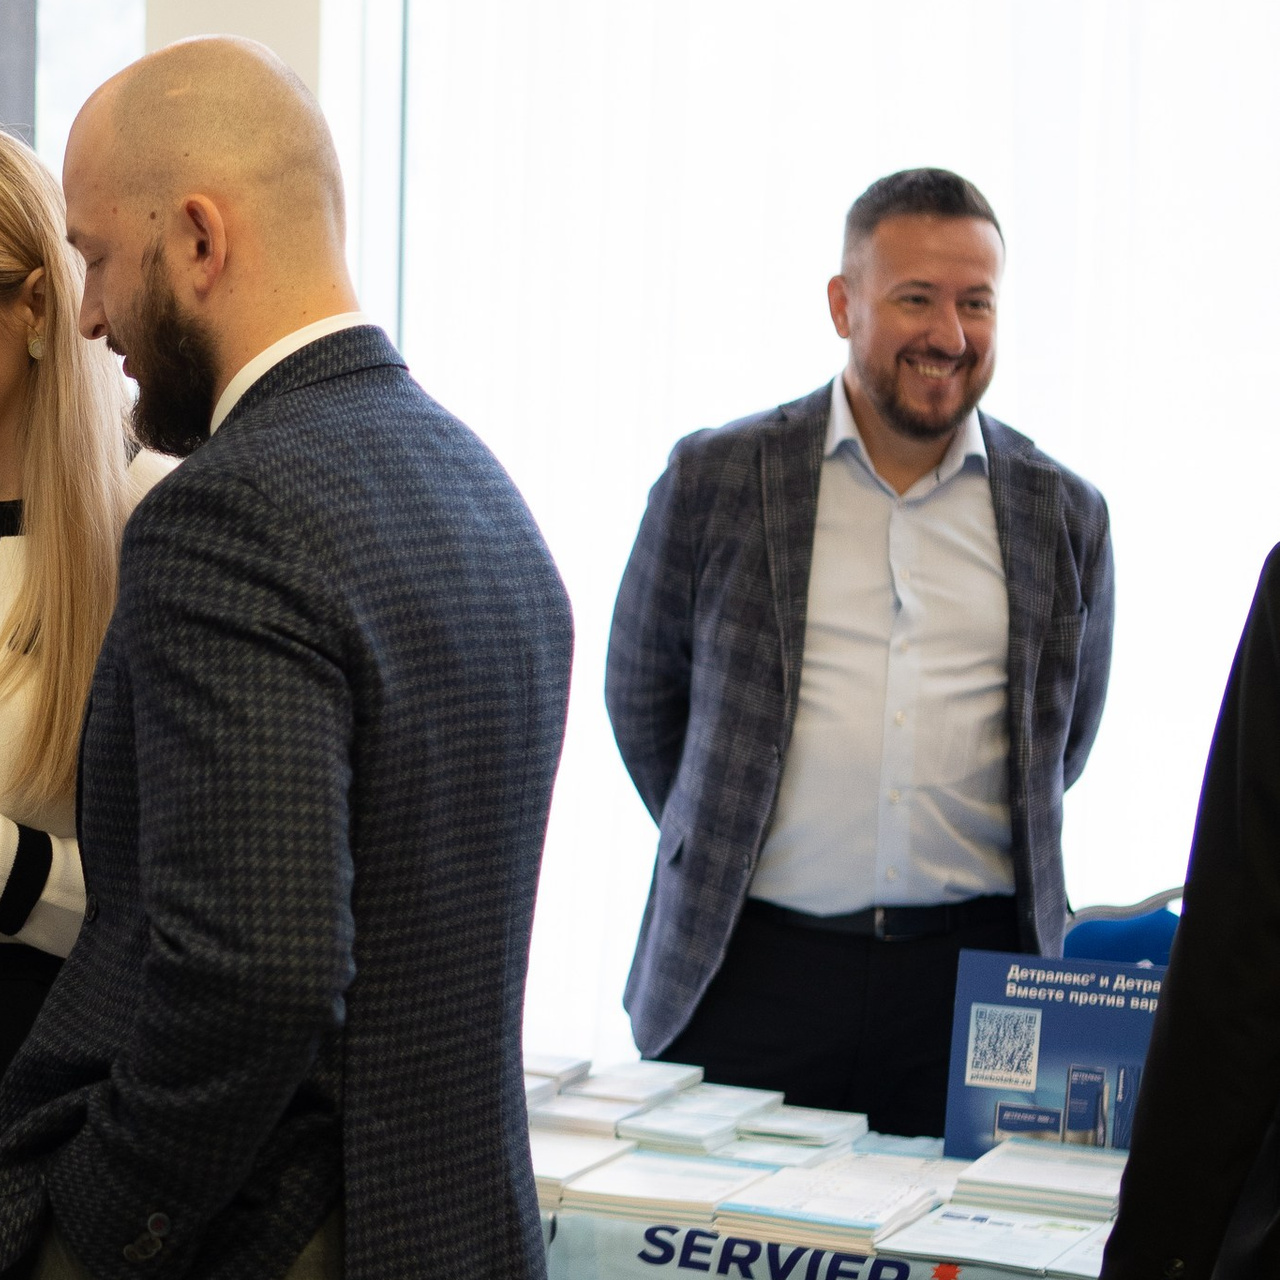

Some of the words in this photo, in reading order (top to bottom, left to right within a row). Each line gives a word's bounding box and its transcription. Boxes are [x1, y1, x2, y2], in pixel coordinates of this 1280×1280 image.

[1100, 976, 1110, 988] и
[1113, 974, 1162, 995] Детра
[1006, 982, 1065, 1003] Вместе
[1069, 990, 1126, 1008] против
[1130, 996, 1159, 1014] вар
